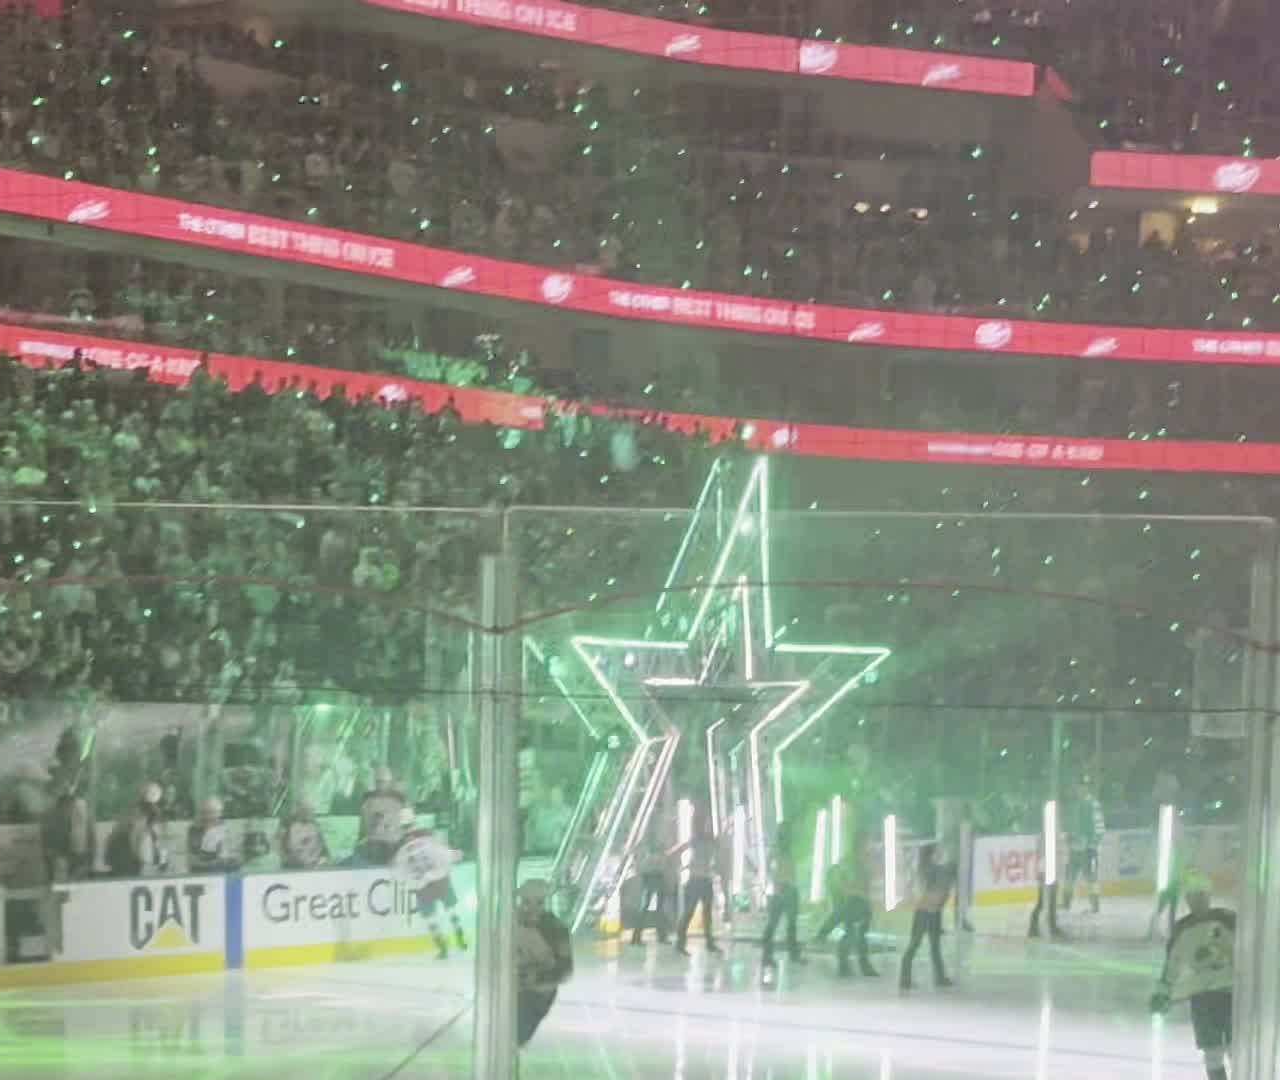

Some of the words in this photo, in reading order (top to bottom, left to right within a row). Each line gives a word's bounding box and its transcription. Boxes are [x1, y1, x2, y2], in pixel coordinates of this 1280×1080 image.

[130, 884, 206, 951] CAT
[261, 882, 360, 923] Great
[367, 878, 419, 928] Clip
